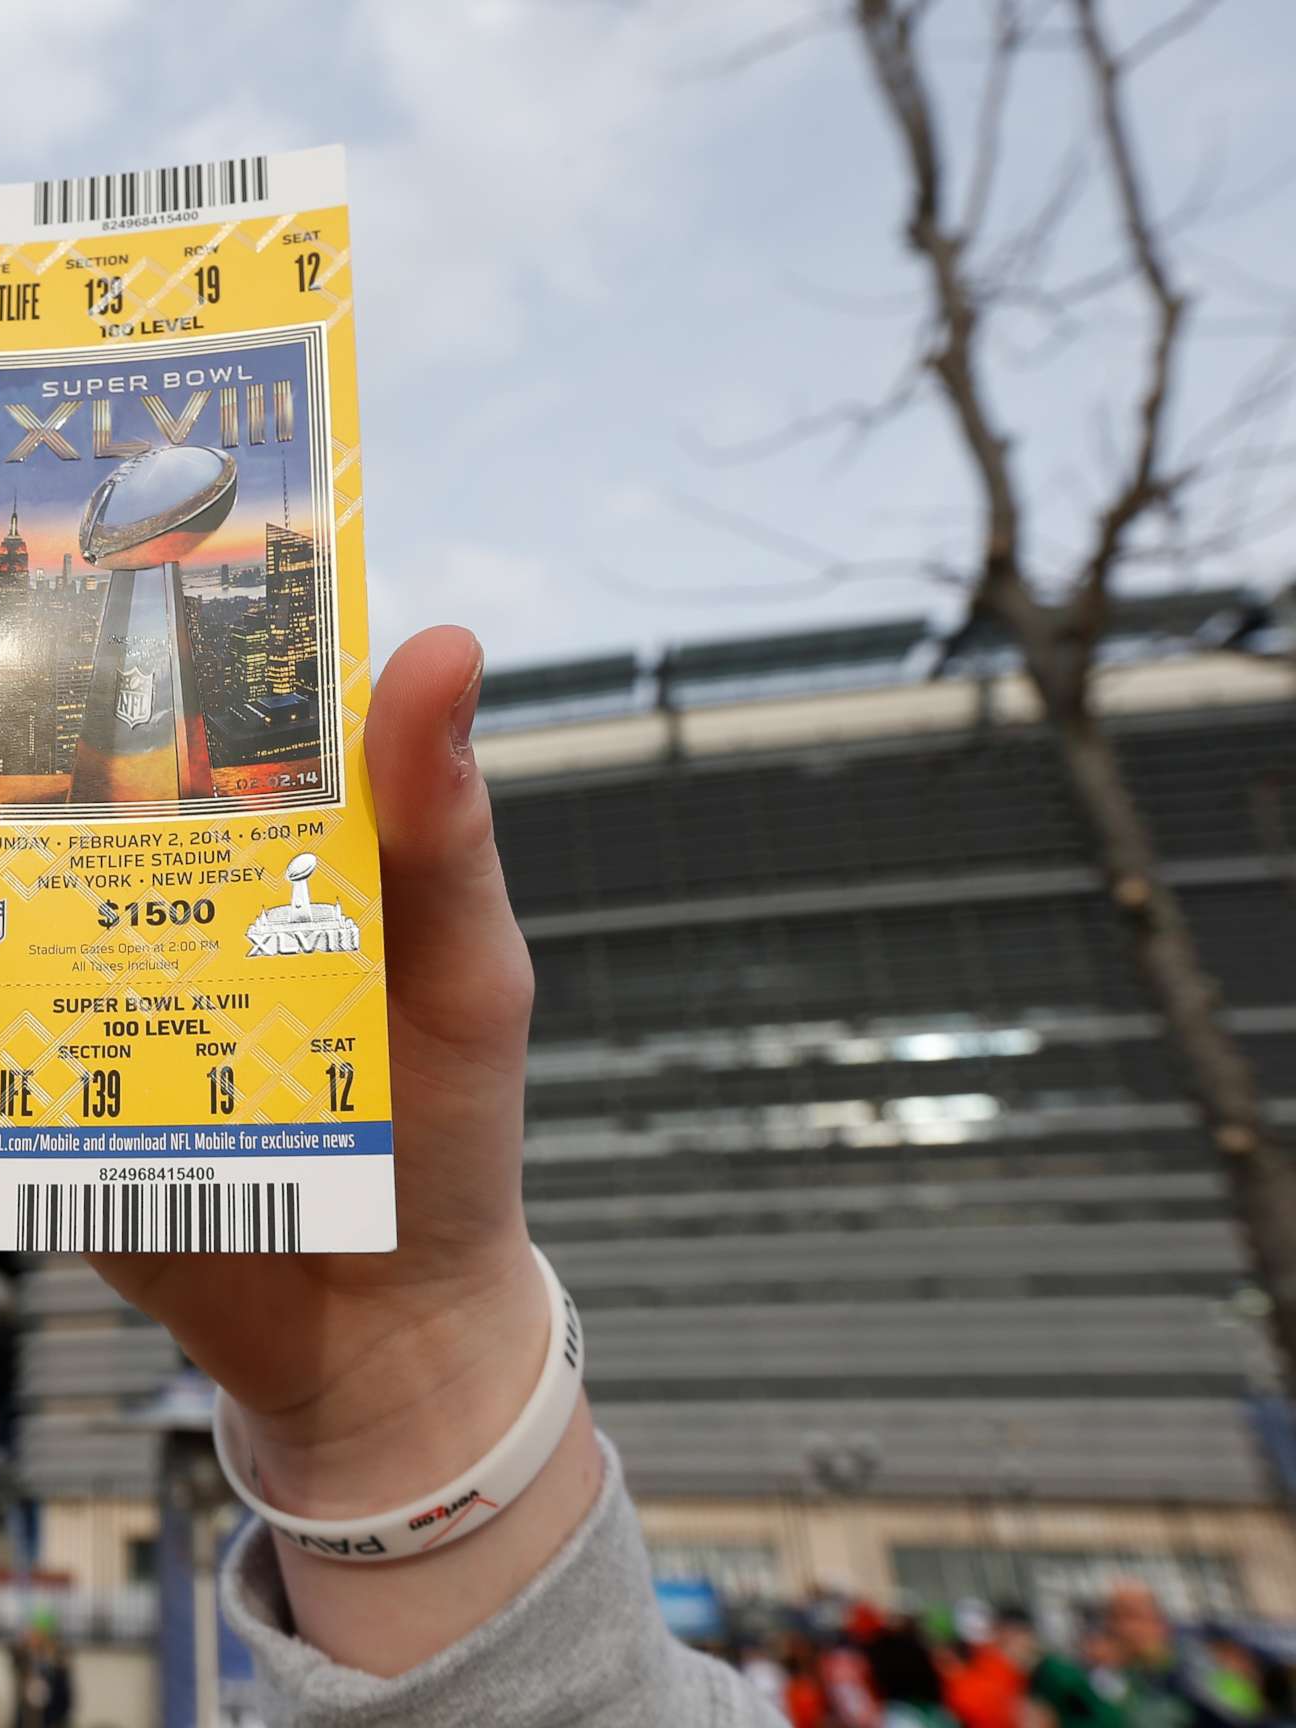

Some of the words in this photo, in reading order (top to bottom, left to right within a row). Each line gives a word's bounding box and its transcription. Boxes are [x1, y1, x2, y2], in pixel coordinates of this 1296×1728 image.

[101, 211, 199, 231] 824968415400
[66, 254, 129, 269] SECTION
[184, 245, 220, 257] ROW
[282, 230, 321, 245] SEAT
[84, 276, 124, 316] 139
[195, 265, 220, 305] 19
[294, 252, 321, 292] 12
[99, 323, 134, 338] 100
[140, 316, 204, 335] LEVEL
[42, 375, 148, 398] SUPER
[164, 365, 253, 389] BOWL
[5, 380, 294, 463] XLVIII
[117, 691, 150, 719] NFL
[69, 834, 162, 849] FEBRUARY
[168, 833, 183, 847] 2,
[190, 830, 231, 845] 2014
[251, 825, 291, 841] 6:00
[298, 822, 324, 837] PM
[70, 854, 145, 869] METLIFE
[151, 850, 231, 866] STADIUM
[38, 875, 78, 889] NEW
[85, 874, 132, 888] YORK
[152, 872, 192, 886] NEW
[198, 867, 265, 885] JERSEY
[98, 899, 215, 930] $1500
[29, 944, 77, 955] Stadium
[80, 944, 115, 955] Gates
[118, 943, 150, 955] Open
[154, 943, 164, 953] at
[168, 941, 196, 952] 2:00
[200, 940, 219, 951] PM
[245, 928, 361, 958] XLVIII
[72, 961, 86, 972] All
[91, 961, 124, 972] Taxes
[127, 959, 179, 971] Included
[53, 998, 118, 1013] SUPER
[125, 996, 184, 1012] BOWL
[192, 993, 249, 1011] XLVIII
[103, 1021, 139, 1037] 100
[145, 1019, 211, 1036] LEVEL
[57, 1045, 131, 1059] SECTION
[196, 1042, 237, 1056] ROW
[310, 1037, 356, 1053] SEAT
[81, 1069, 121, 1118] 139
[207, 1065, 234, 1115] 19
[325, 1062, 354, 1112] 12
[83, 1133, 105, 1151] and
[109, 1132, 167, 1151] download
[170, 1133, 191, 1150] NFL
[194, 1132, 236, 1150] Mobile
[239, 1131, 258, 1149] for
[261, 1131, 319, 1149] exclusive
[323, 1132, 355, 1148] news
[99, 1167, 215, 1181] 824968415400
[408, 1489, 480, 1531] verizon
